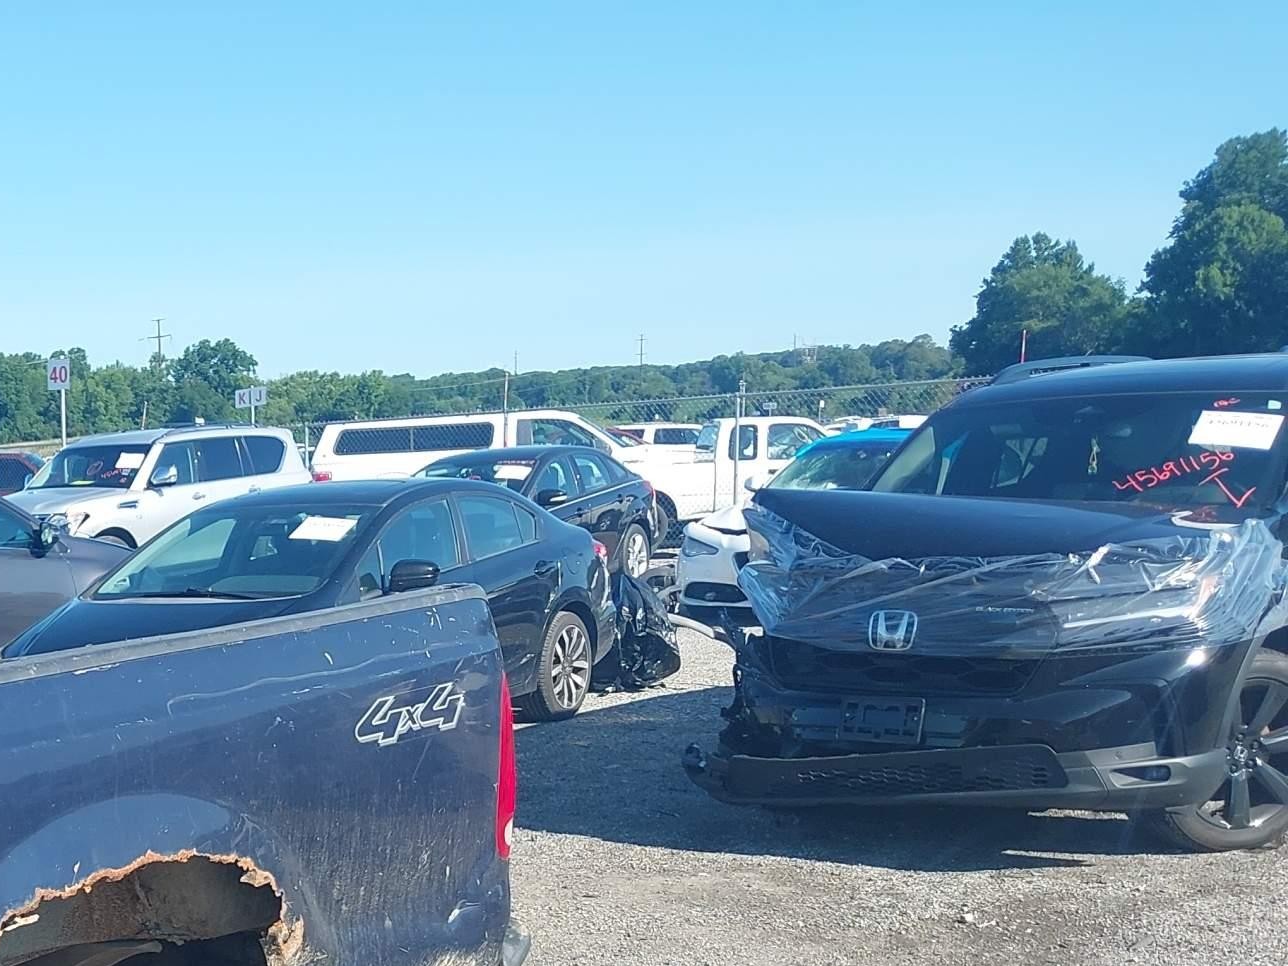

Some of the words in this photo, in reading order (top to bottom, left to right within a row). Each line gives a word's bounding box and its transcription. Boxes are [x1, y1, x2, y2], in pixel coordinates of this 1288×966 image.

[49, 365, 68, 384] 40
[238, 391, 247, 405] K
[255, 390, 262, 402] J
[1112, 449, 1235, 492] 45691156
[355, 682, 465, 747] 4x4
